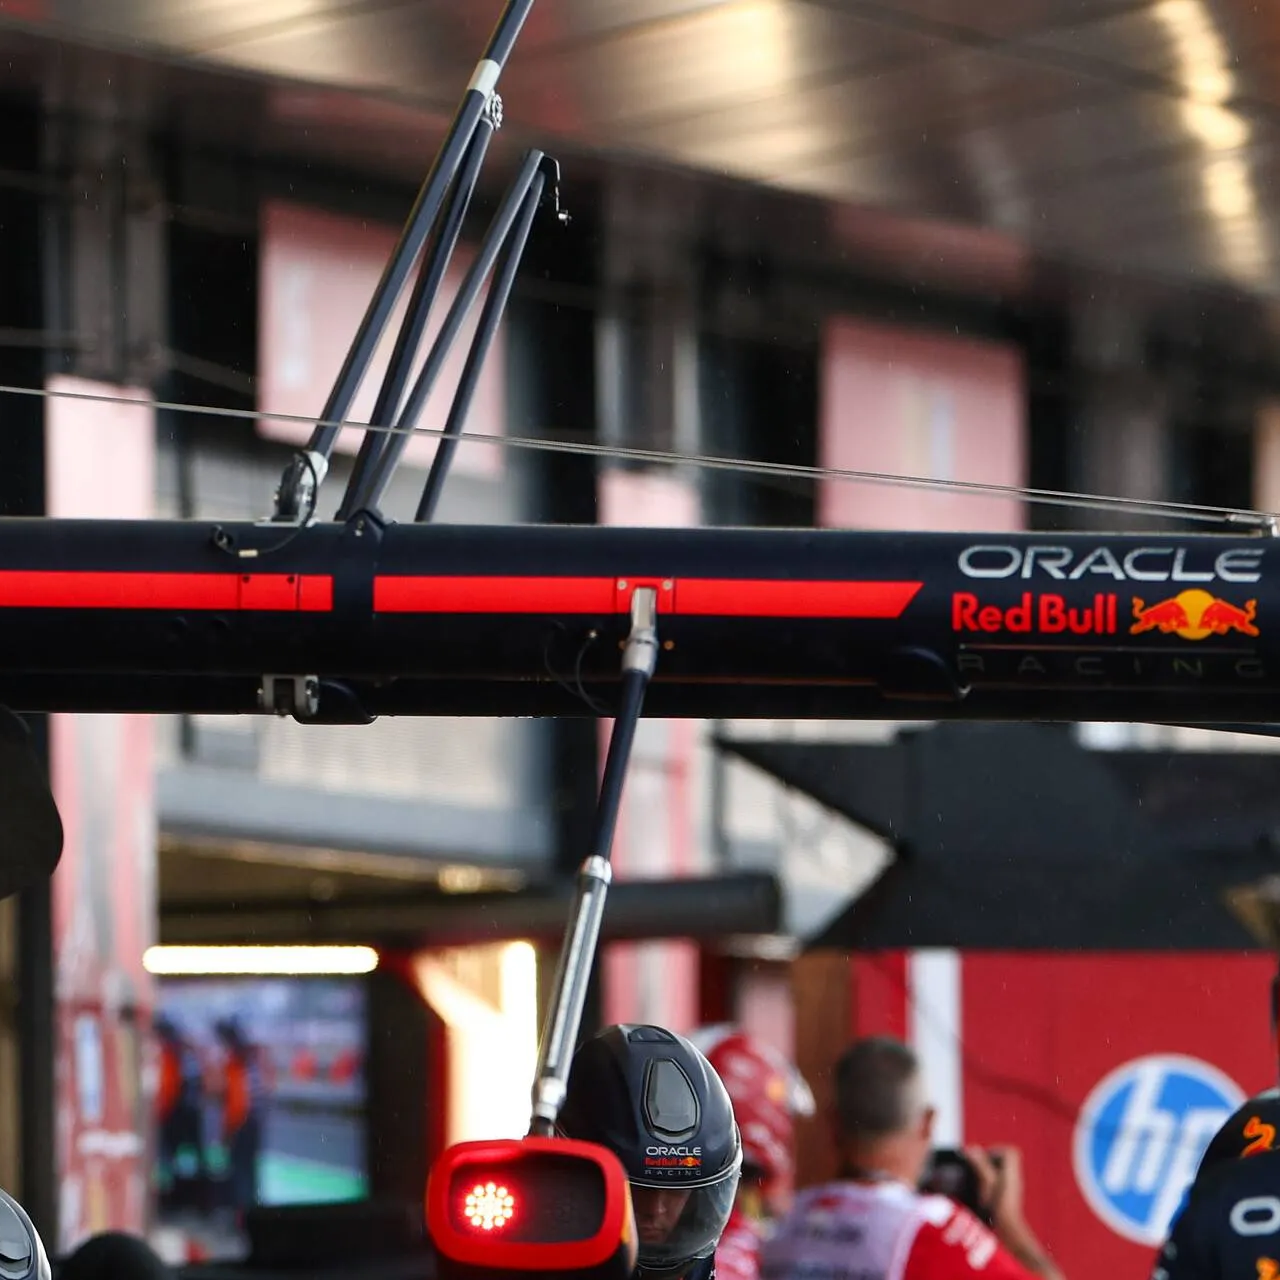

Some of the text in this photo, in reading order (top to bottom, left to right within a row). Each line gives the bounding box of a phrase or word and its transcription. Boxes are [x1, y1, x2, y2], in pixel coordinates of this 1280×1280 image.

[958, 545, 1264, 582] ORACLE
[952, 592, 1117, 635] Red Bull
[646, 1147, 701, 1156] ORACLE
